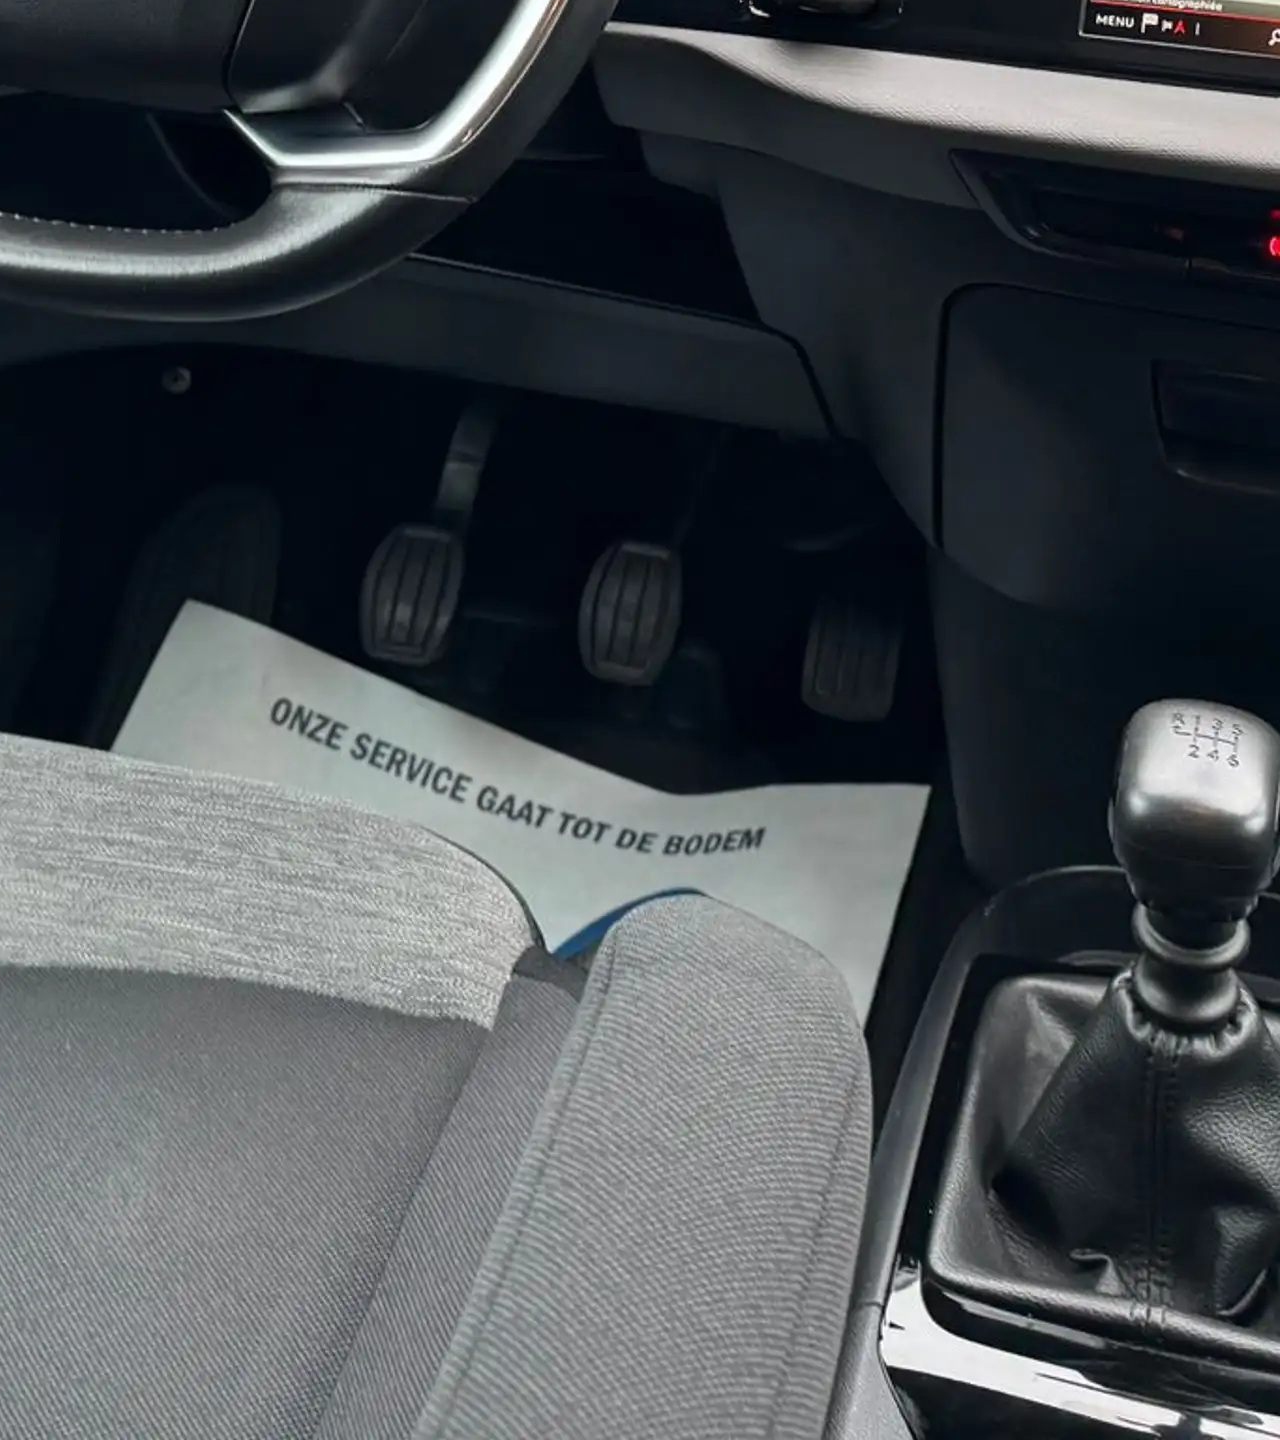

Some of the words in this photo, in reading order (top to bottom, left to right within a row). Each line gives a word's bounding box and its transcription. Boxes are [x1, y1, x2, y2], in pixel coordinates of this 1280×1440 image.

[1095, 13, 1135, 29] MENU
[1172, 712, 1185, 726] R
[1188, 743, 1200, 759] 2
[270, 697, 348, 750] ONZE
[350, 733, 472, 803] SERVICE
[476, 785, 553, 828] GAAT
[558, 812, 611, 843] TOT
[615, 828, 658, 854] DE
[662, 827, 767, 856] BODEM
